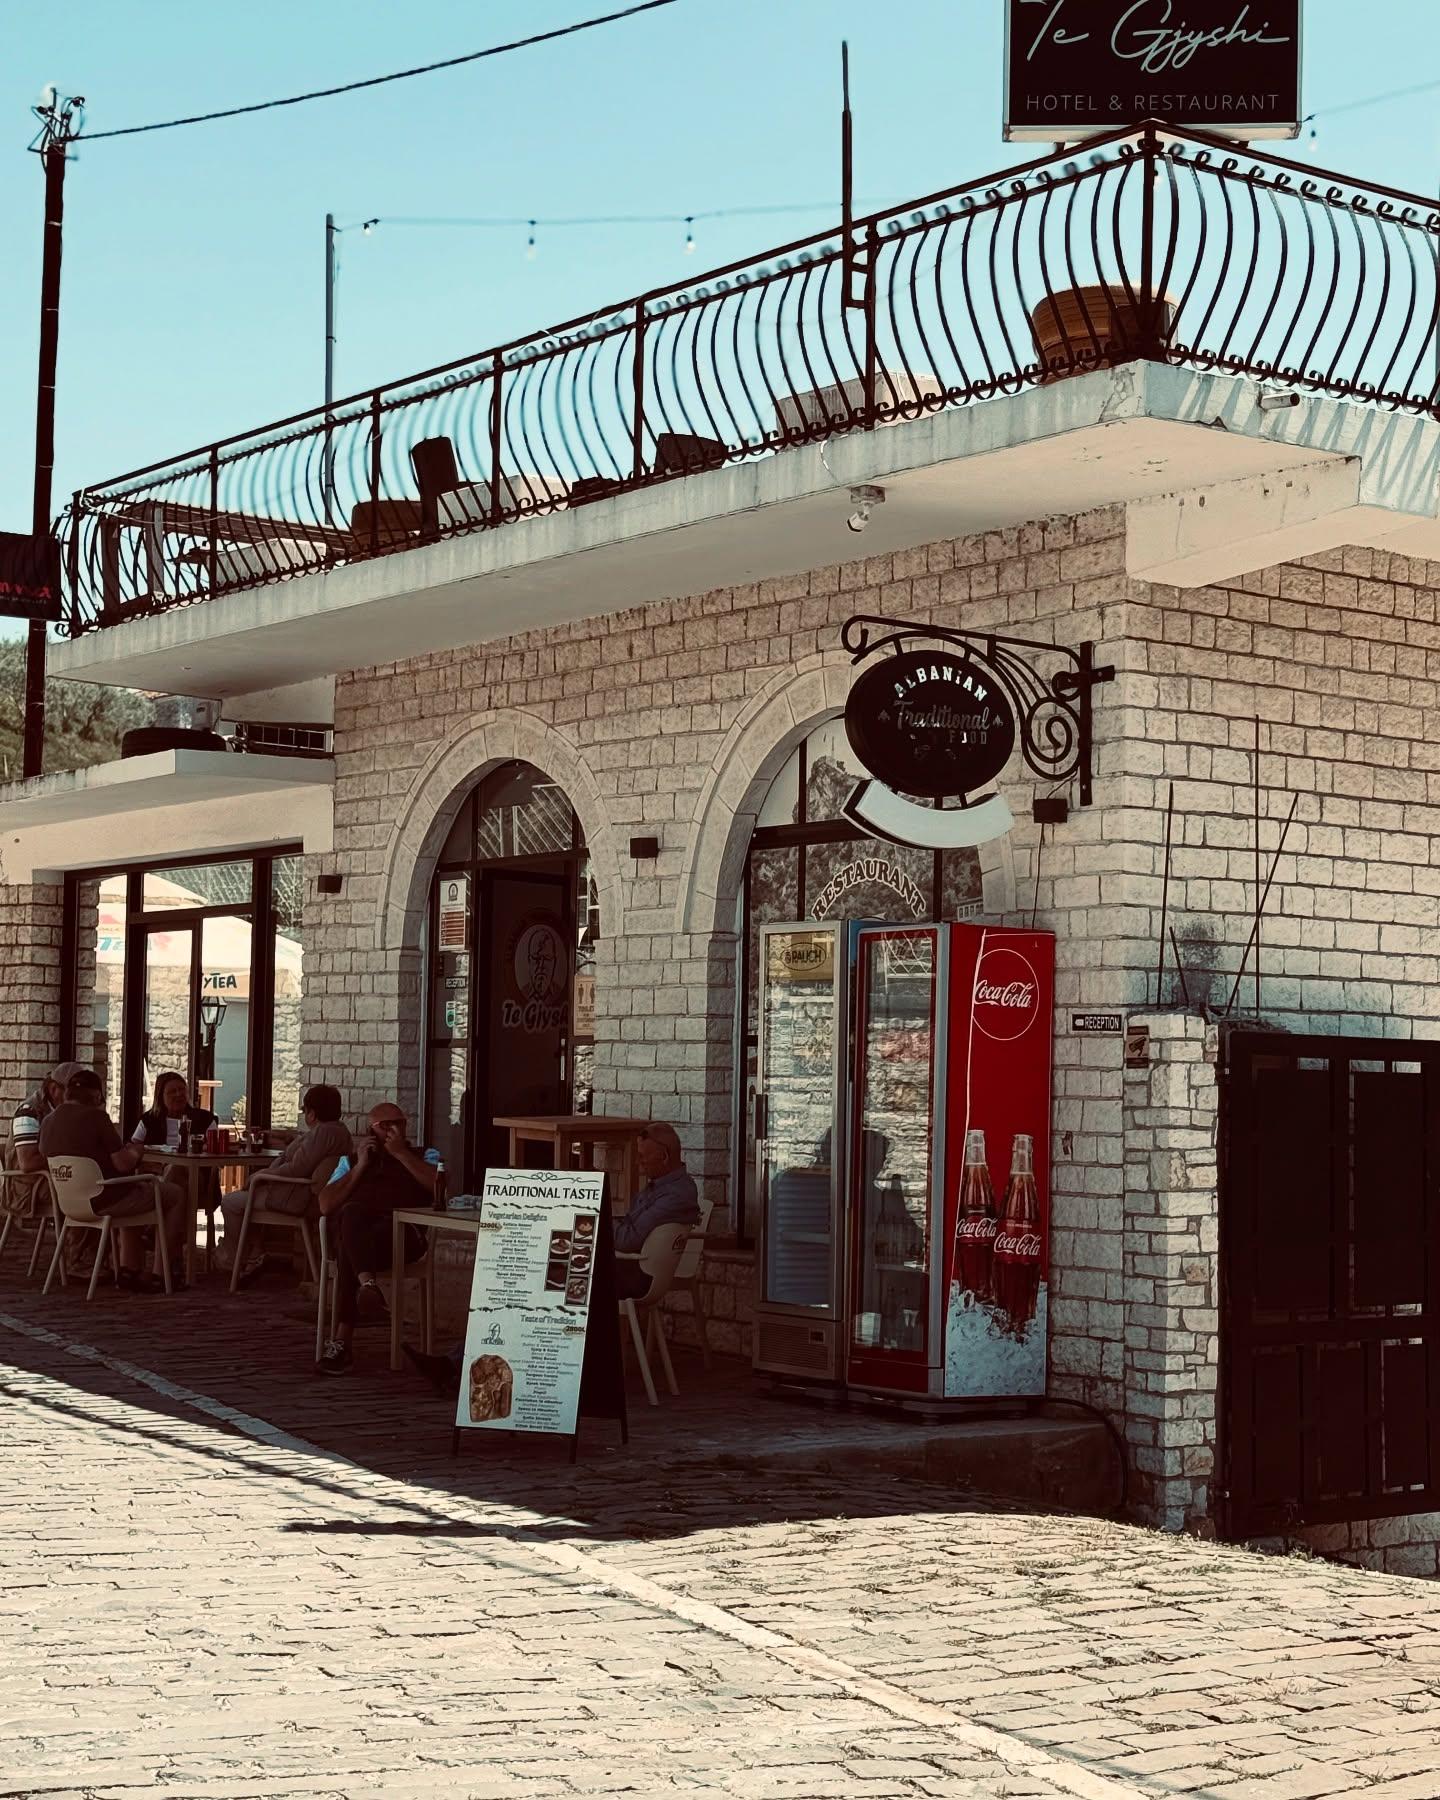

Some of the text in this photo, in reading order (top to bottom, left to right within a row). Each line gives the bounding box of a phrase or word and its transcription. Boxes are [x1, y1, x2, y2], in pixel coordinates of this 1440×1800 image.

[1019, 0, 1290, 73] Te Gjyshi
[1026, 94, 1279, 111] HOTEL & RESTAURANT
[894, 665, 987, 702] ALBANIAN
[893, 700, 990, 730] Traditional
[811, 858, 926, 921] RESTAURANT
[791, 949, 822, 963] RAUCH
[201, 972, 238, 989] YTEA
[973, 979, 1035, 1008] Coca-Cola
[1084, 1015, 1120, 1030] RECEPTION
[486, 1184, 600, 1201] TRADITIONAL TASTE
[487, 1211, 522, 1221] Vegetarian
[956, 1217, 999, 1238] Coca-Cola
[993, 1231, 1041, 1256] Coca-Cola
[520, 1314, 538, 1323] Taste
[546, 1315, 577, 1325] Tradition
